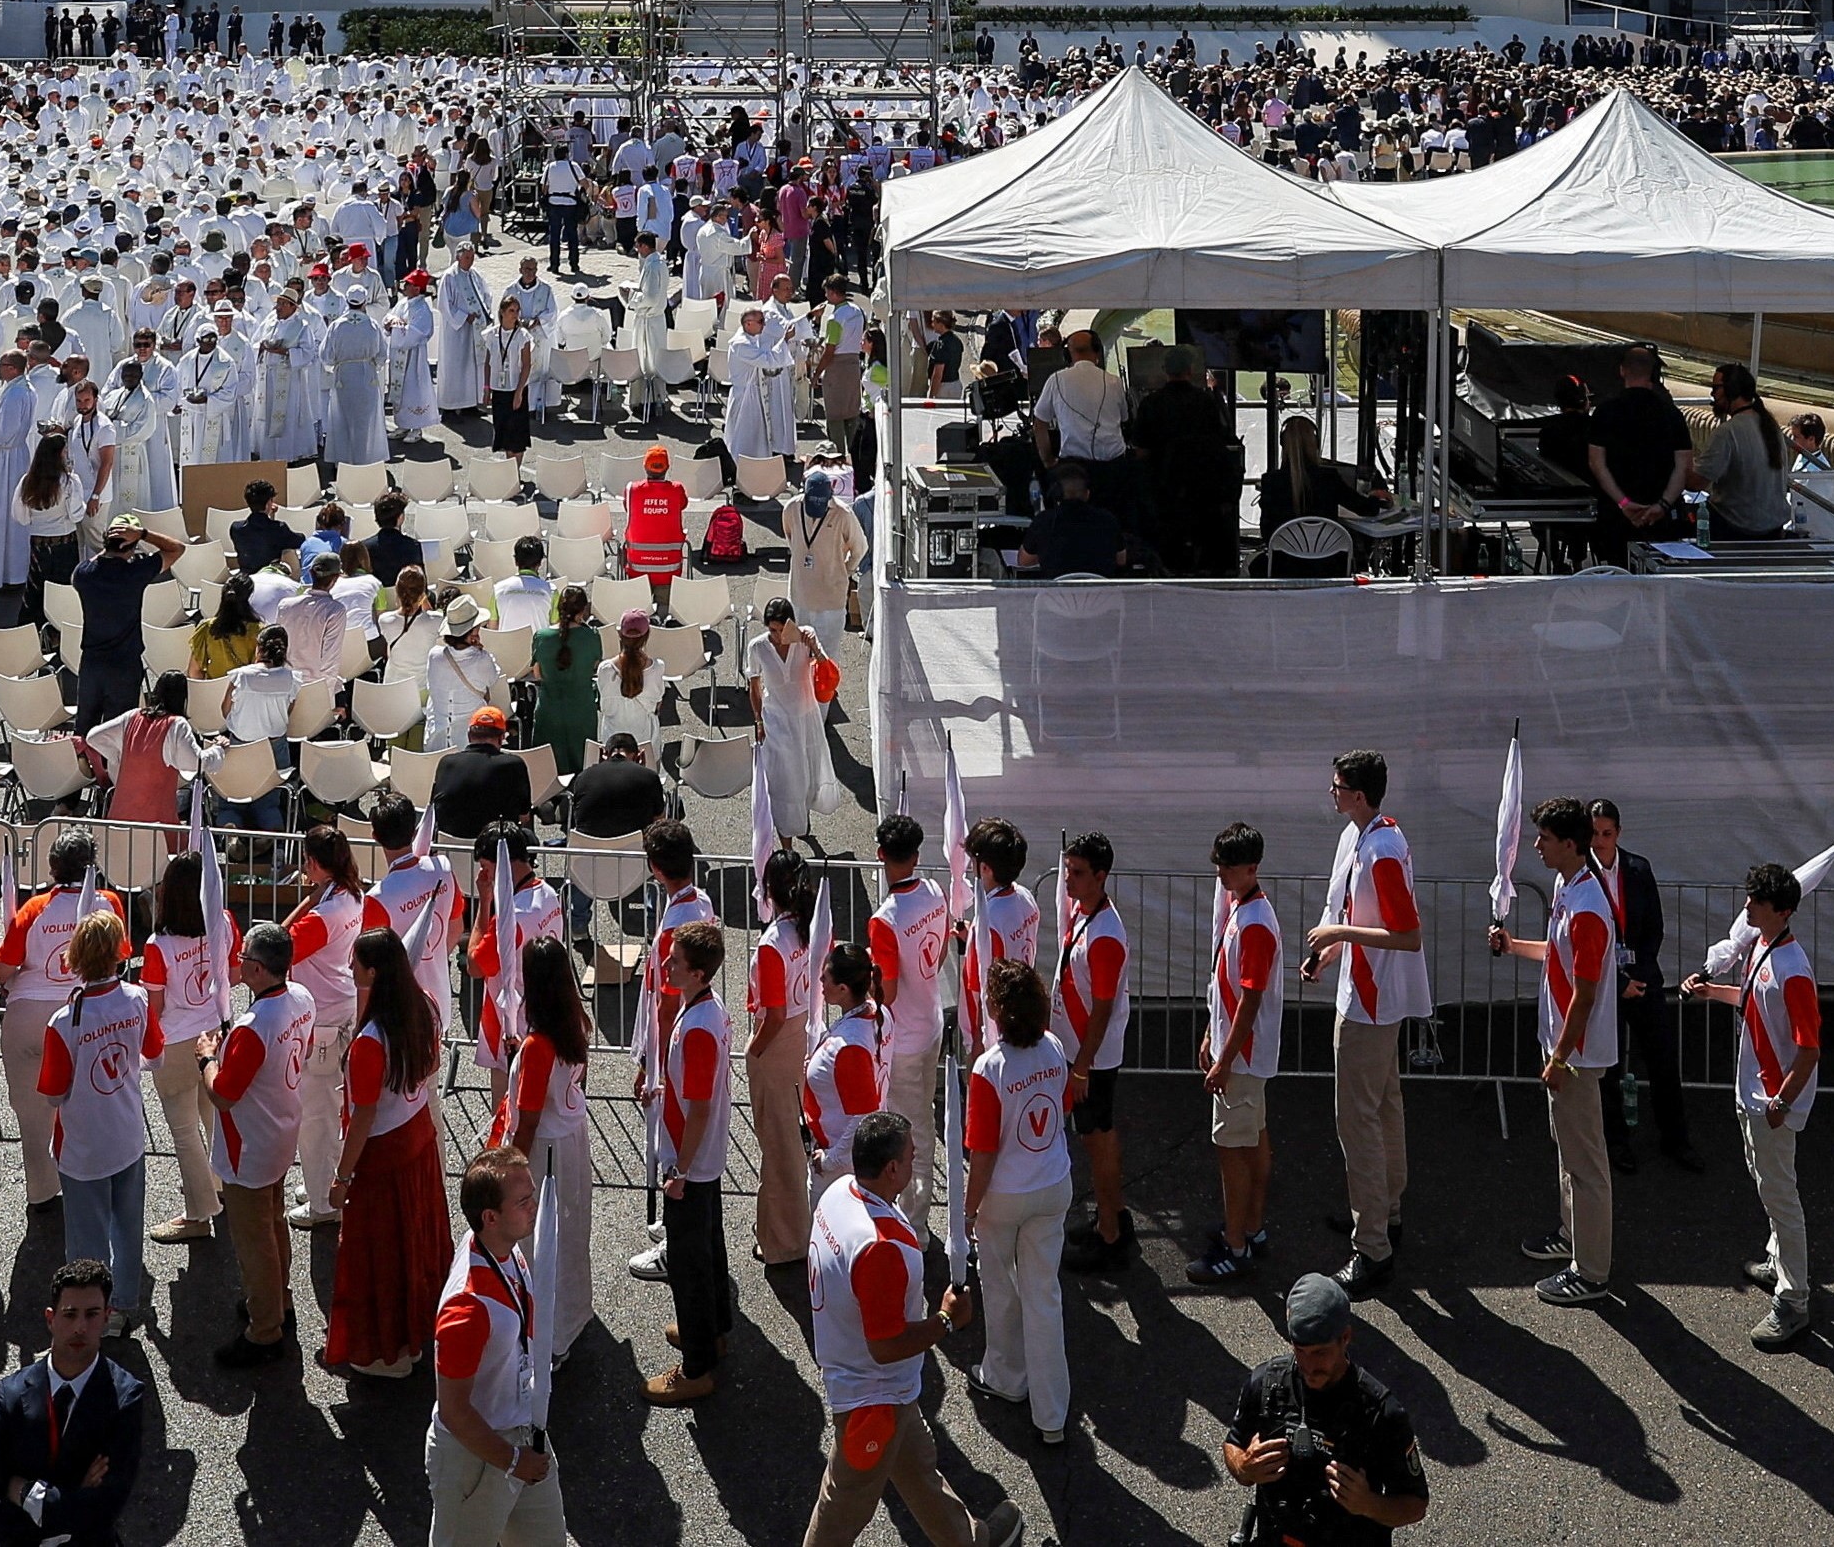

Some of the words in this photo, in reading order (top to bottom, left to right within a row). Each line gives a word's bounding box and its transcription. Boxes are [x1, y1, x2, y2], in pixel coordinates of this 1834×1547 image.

[643, 507, 668, 515] EQUIPO
[904, 904, 945, 938] VOLUNTARIO
[78, 1016, 141, 1046] VOLUNTARIO
[101, 1053, 121, 1080] V
[1007, 1065, 1062, 1095] VOLUNTARIO
[1028, 1107, 1049, 1137] V
